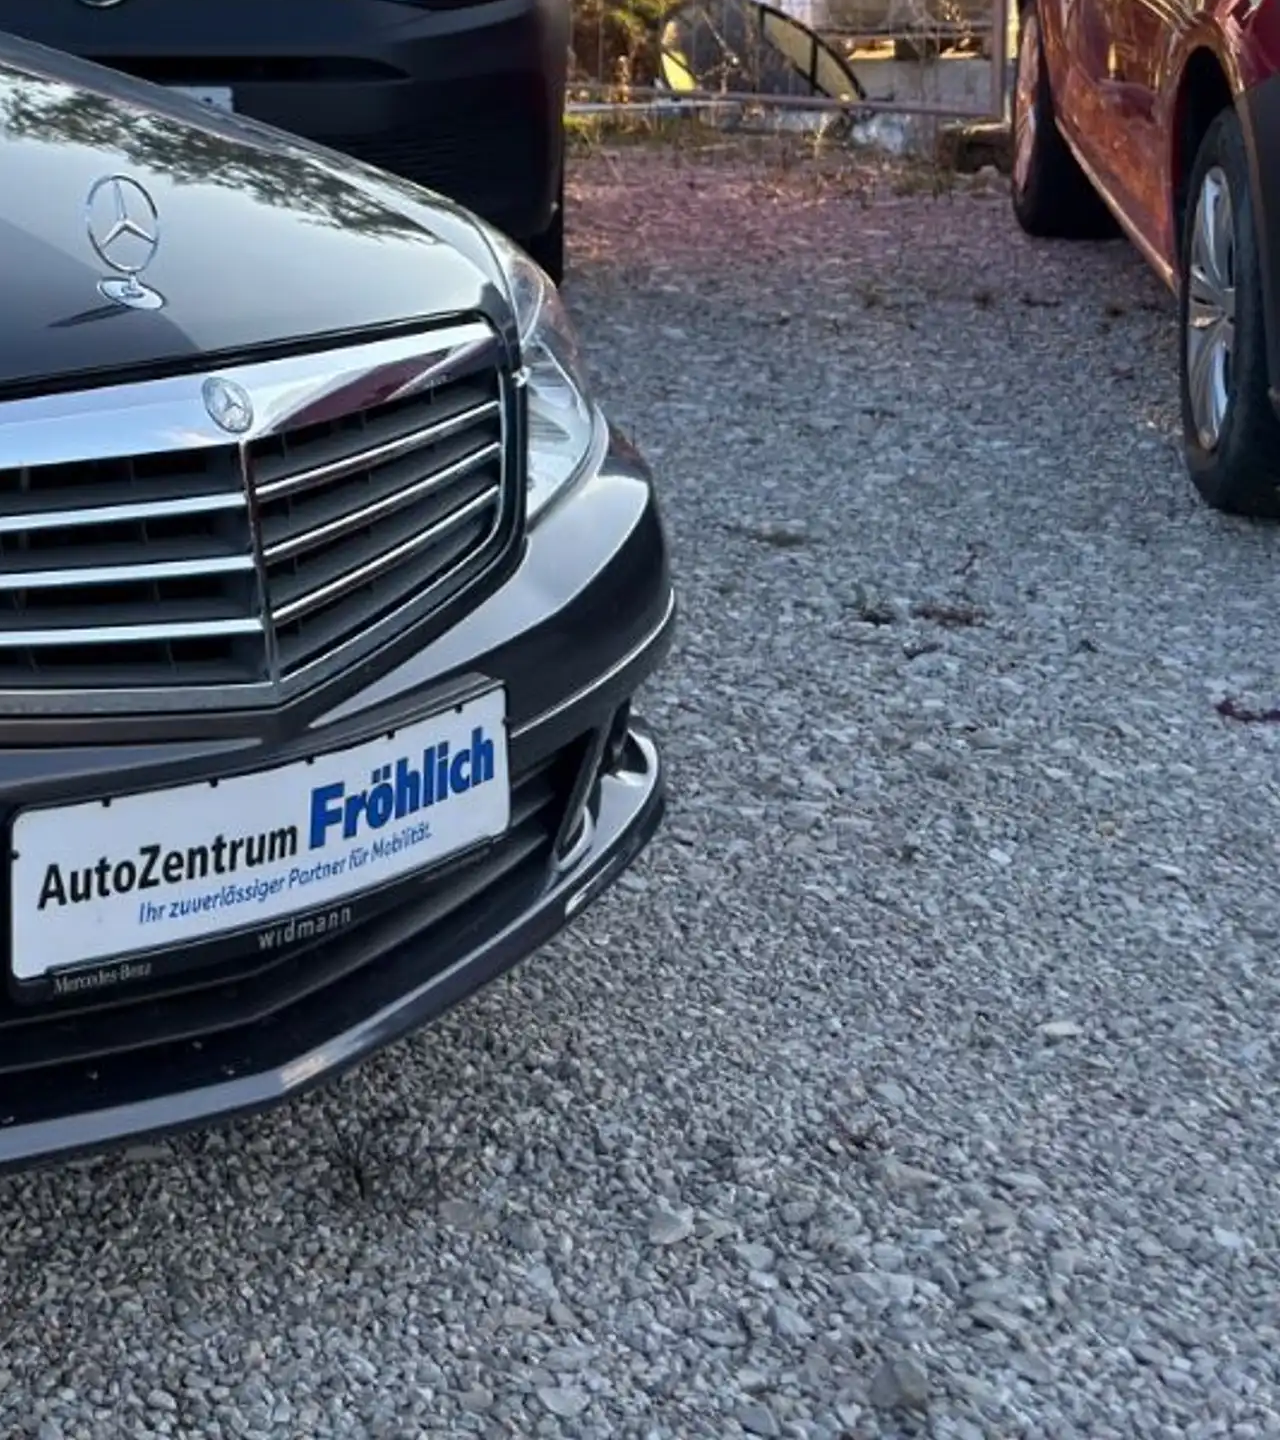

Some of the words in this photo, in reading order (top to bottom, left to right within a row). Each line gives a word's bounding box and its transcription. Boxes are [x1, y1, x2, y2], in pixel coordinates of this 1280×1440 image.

[37, 824, 298, 910] AutoZentrum
[309, 725, 495, 850] Fröhlich
[139, 900, 166, 923] Ihr
[169, 875, 286, 919] zuverlässiger
[288, 856, 346, 889] Partner
[348, 846, 369, 870] für
